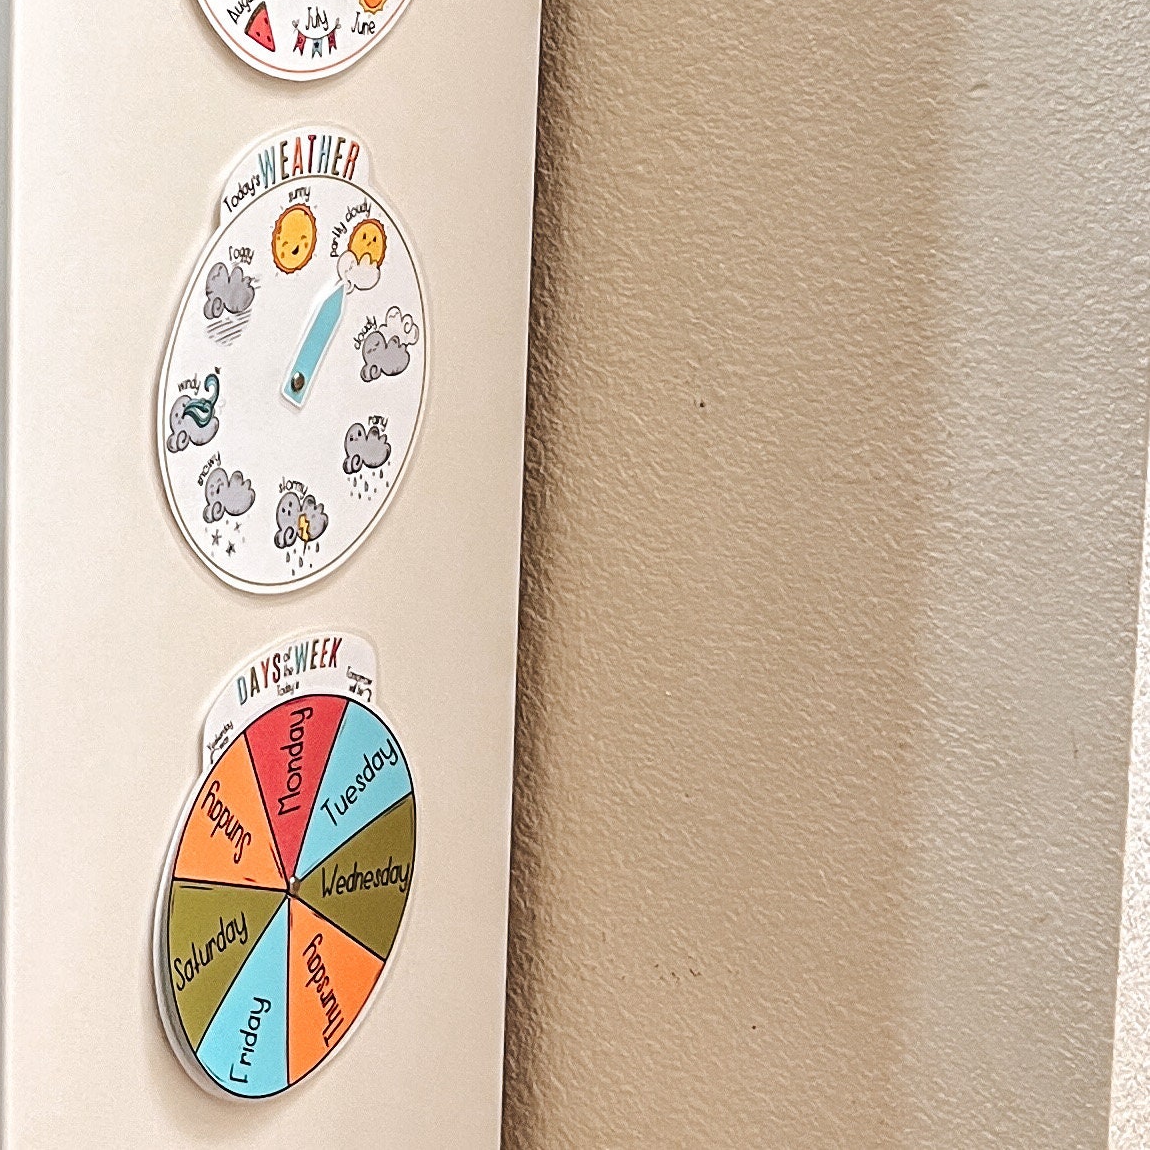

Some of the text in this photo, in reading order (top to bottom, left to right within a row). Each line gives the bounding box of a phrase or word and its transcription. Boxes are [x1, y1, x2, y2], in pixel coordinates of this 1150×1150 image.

[306, 6, 330, 32] July
[351, 11, 376, 36] June
[222, 134, 360, 213] Today's WEATHER
[330, 199, 372, 257] partly cloudy
[228, 245, 255, 264] foggy
[353, 315, 377, 350] cloudy
[177, 373, 202, 396] windy
[367, 414, 390, 432] rainy
[197, 450, 222, 487] snowy
[278, 476, 309, 498] stormy
[236, 636, 343, 706] DAYS WEEK
[277, 707, 313, 816] Monday
[320, 738, 399, 827] Tuesday
[200, 780, 252, 864] Sunday
[321, 856, 411, 898] Wednesday
[173, 910, 249, 991] Saturday
[302, 933, 345, 1047] Thursday
[229, 996, 272, 1084] Friday
